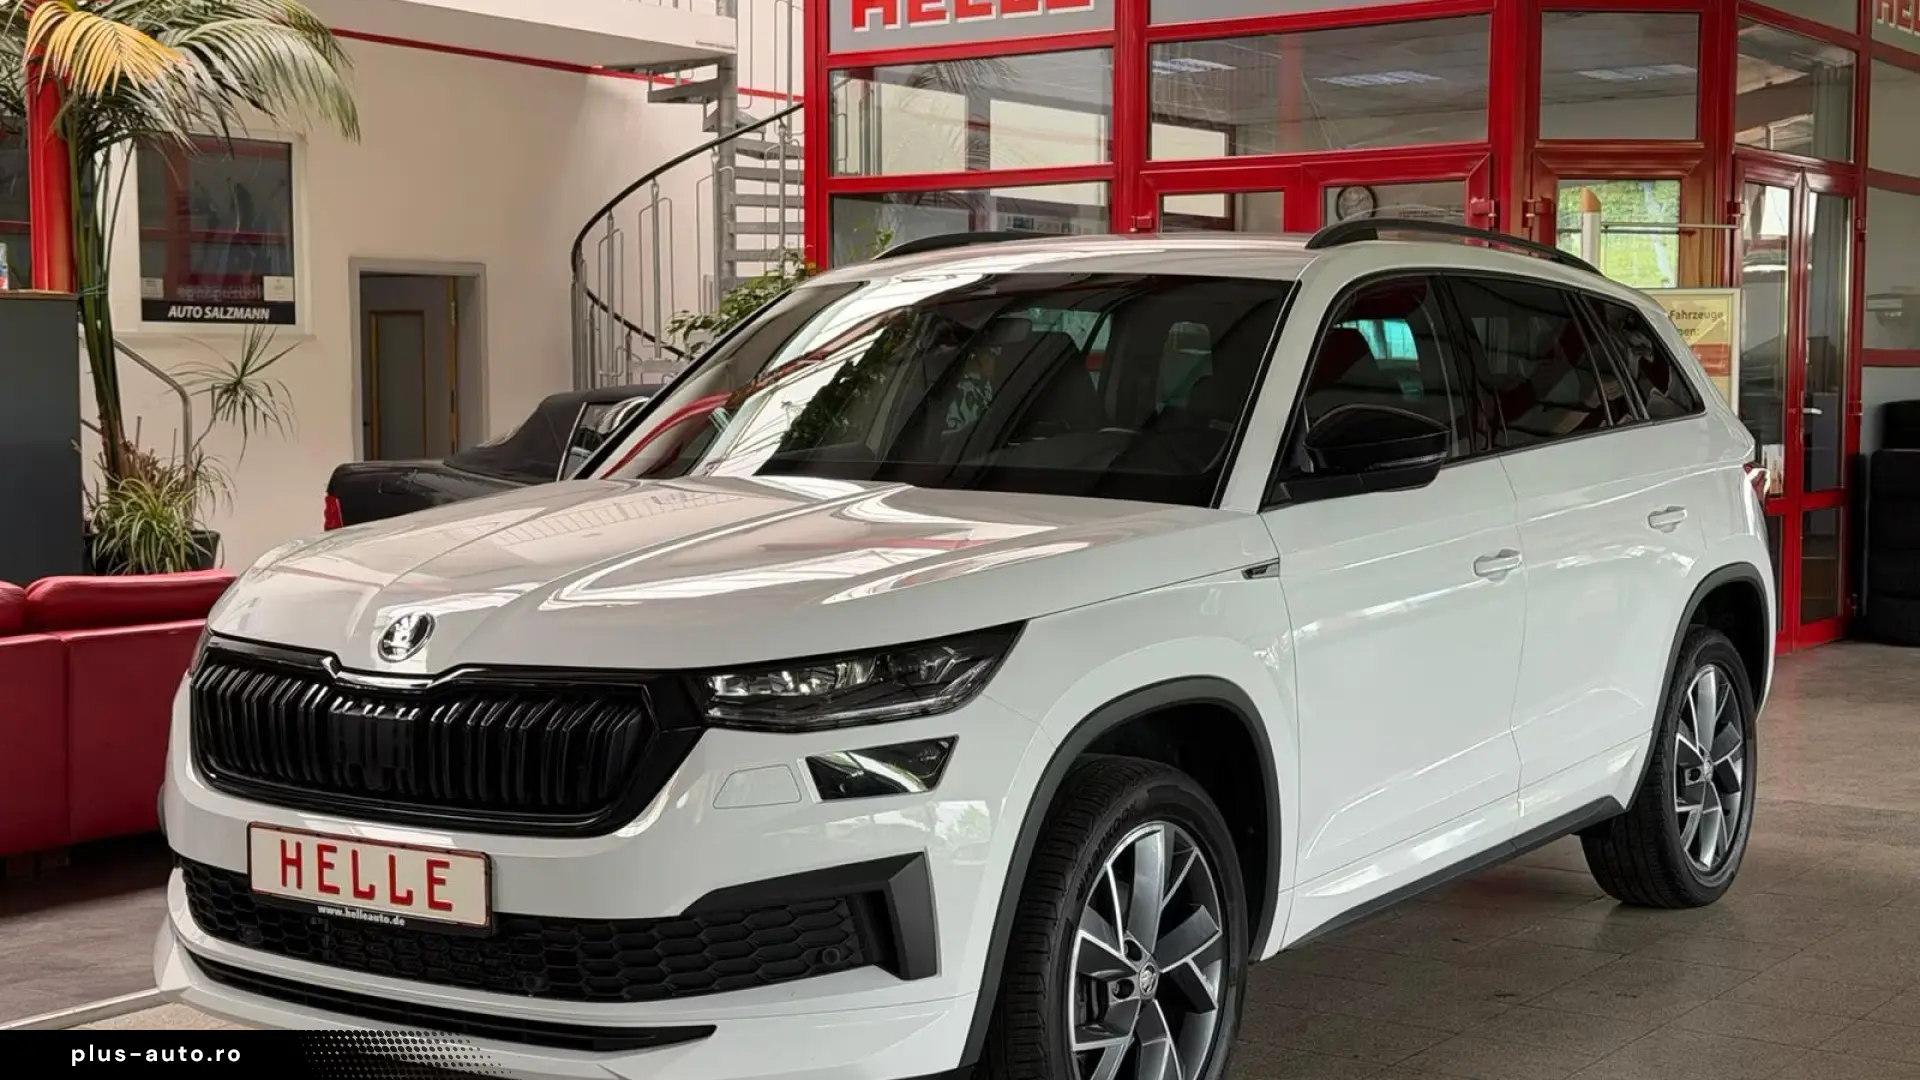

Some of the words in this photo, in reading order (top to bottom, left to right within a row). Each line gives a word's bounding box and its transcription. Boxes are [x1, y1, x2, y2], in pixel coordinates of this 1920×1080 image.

[168, 305, 201, 318] AUTO
[203, 306, 270, 319] SALZMANN
[1669, 310, 1724, 321] Fahrzeuge
[280, 838, 453, 912] HELLE
[317, 904, 405, 927] www.helleauto.de
